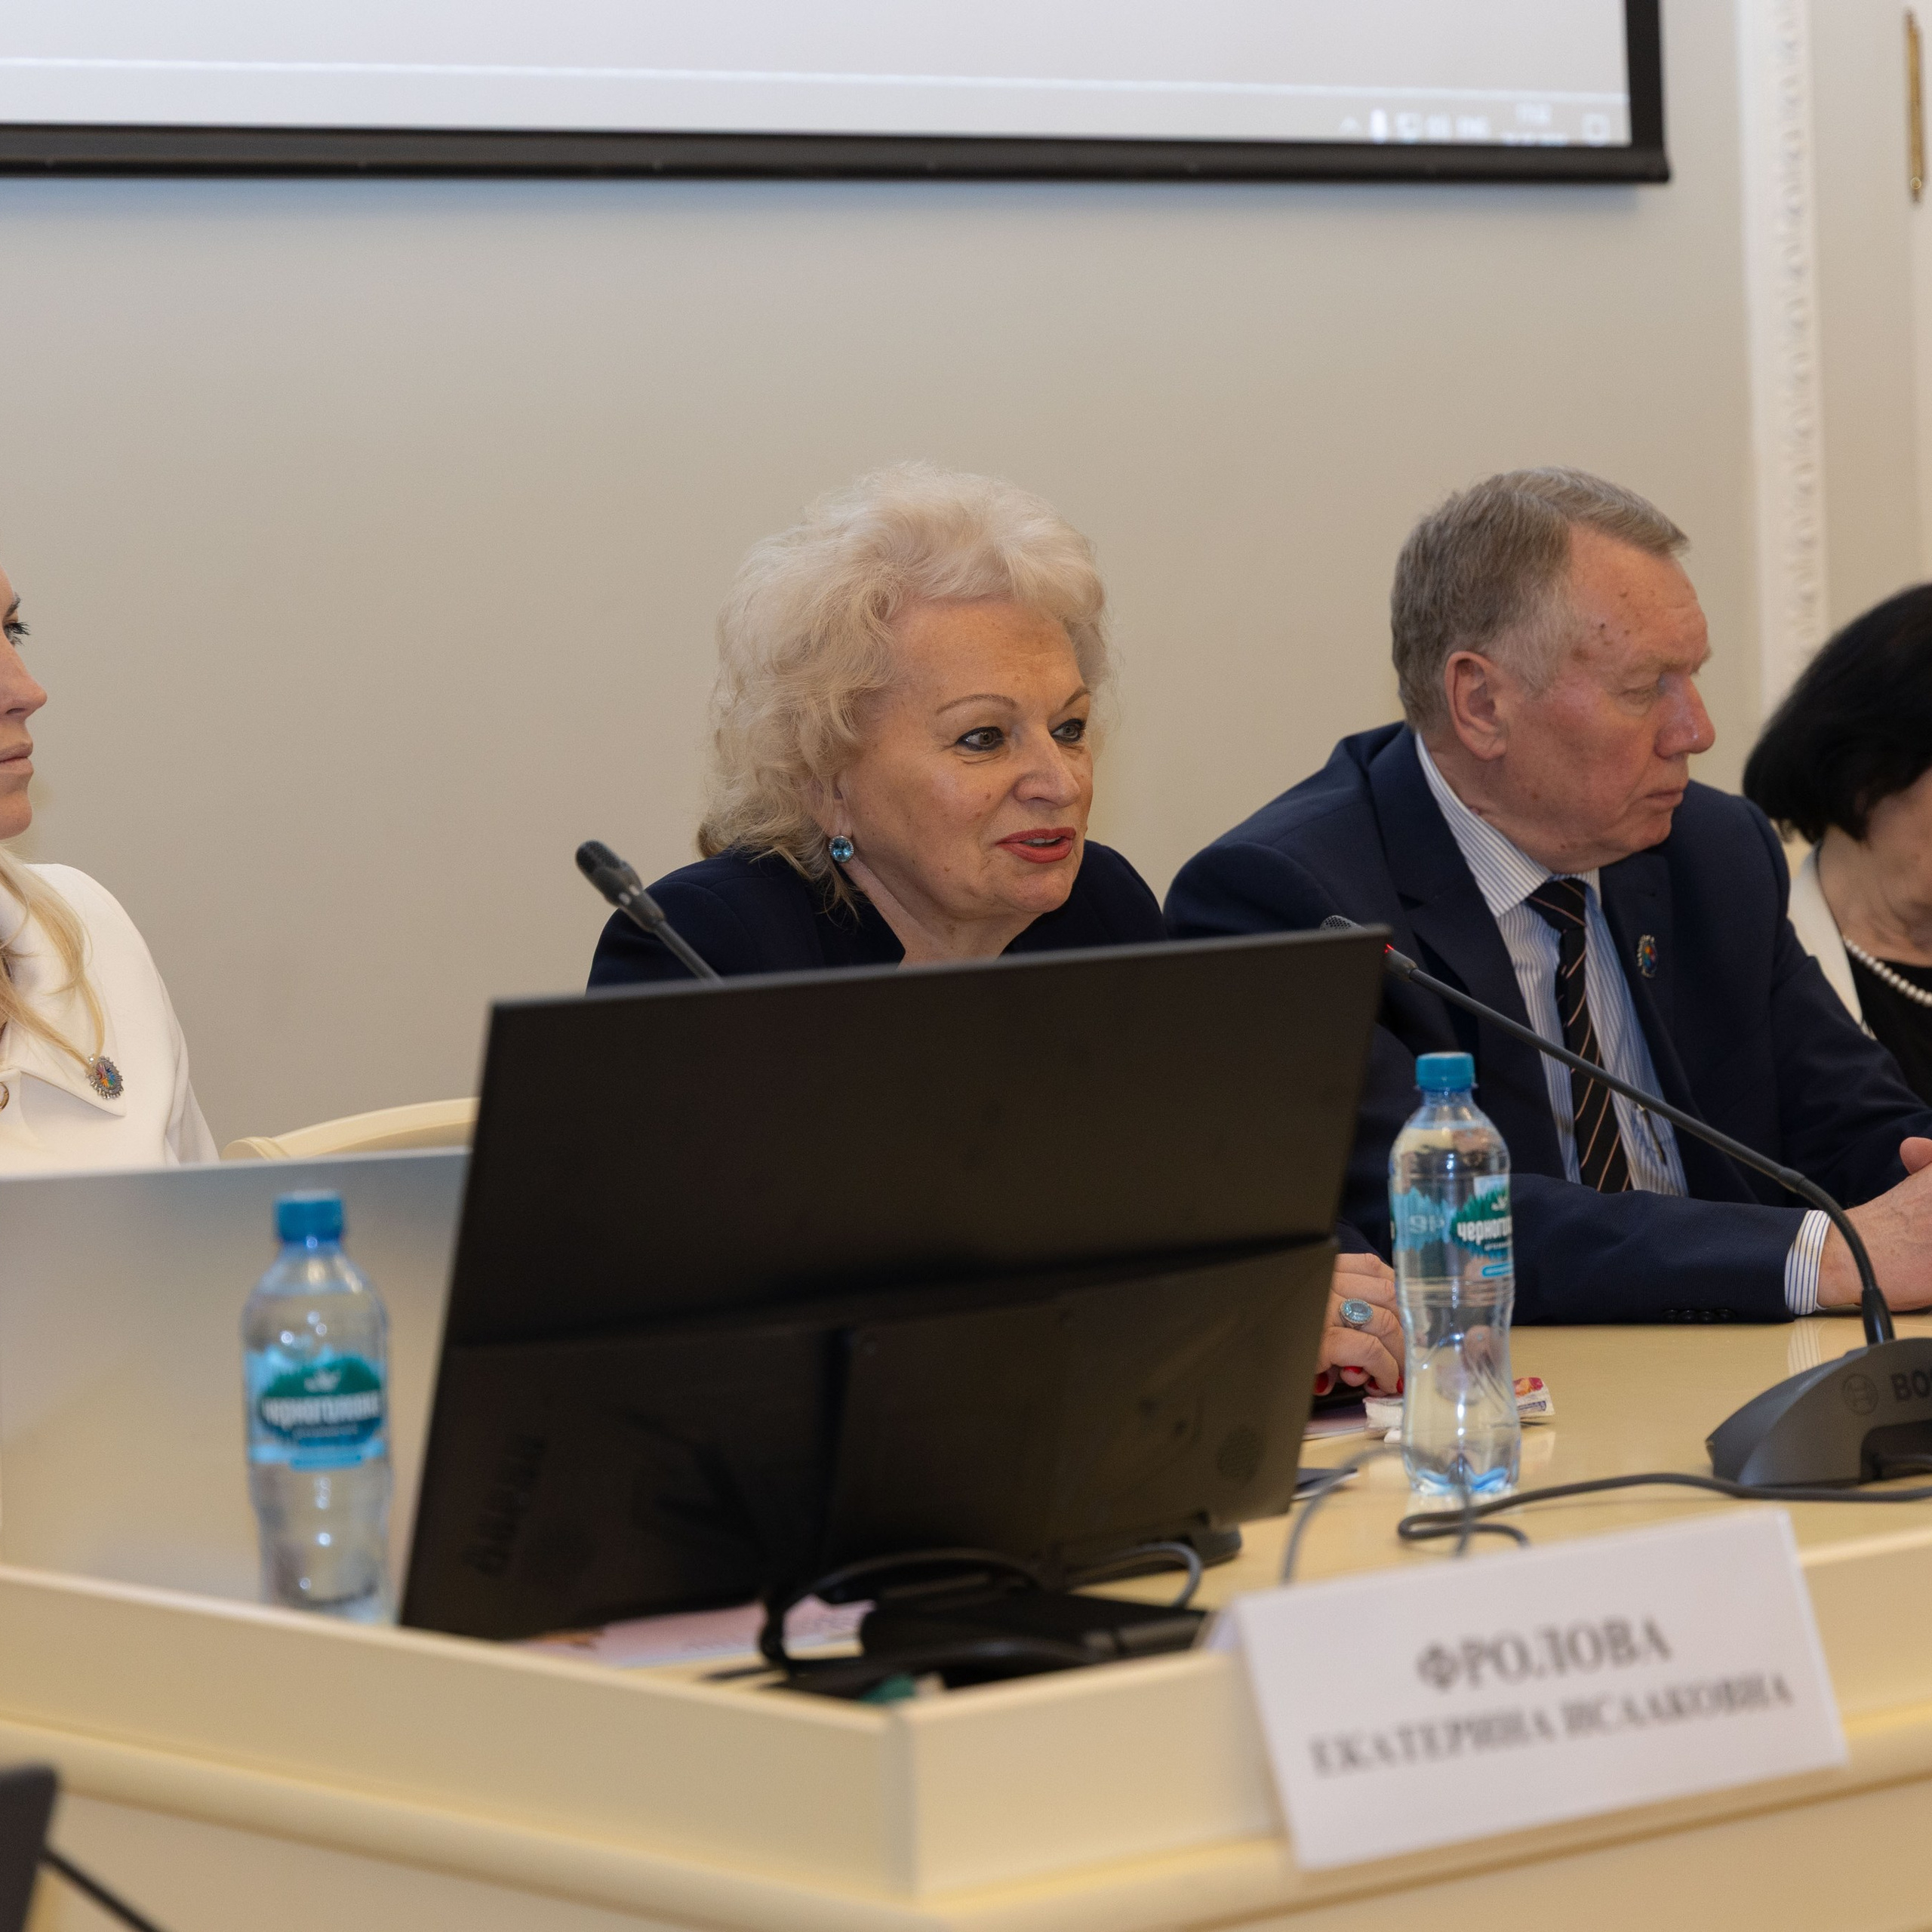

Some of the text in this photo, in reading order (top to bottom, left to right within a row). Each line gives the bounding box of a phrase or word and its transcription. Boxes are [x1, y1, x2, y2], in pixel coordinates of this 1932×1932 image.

[1891, 1369, 1932, 1401] BO
[1414, 1615, 1672, 1692] ФРОЛОВА
[1309, 1707, 1556, 1777] ЕКАТЕРИНА
